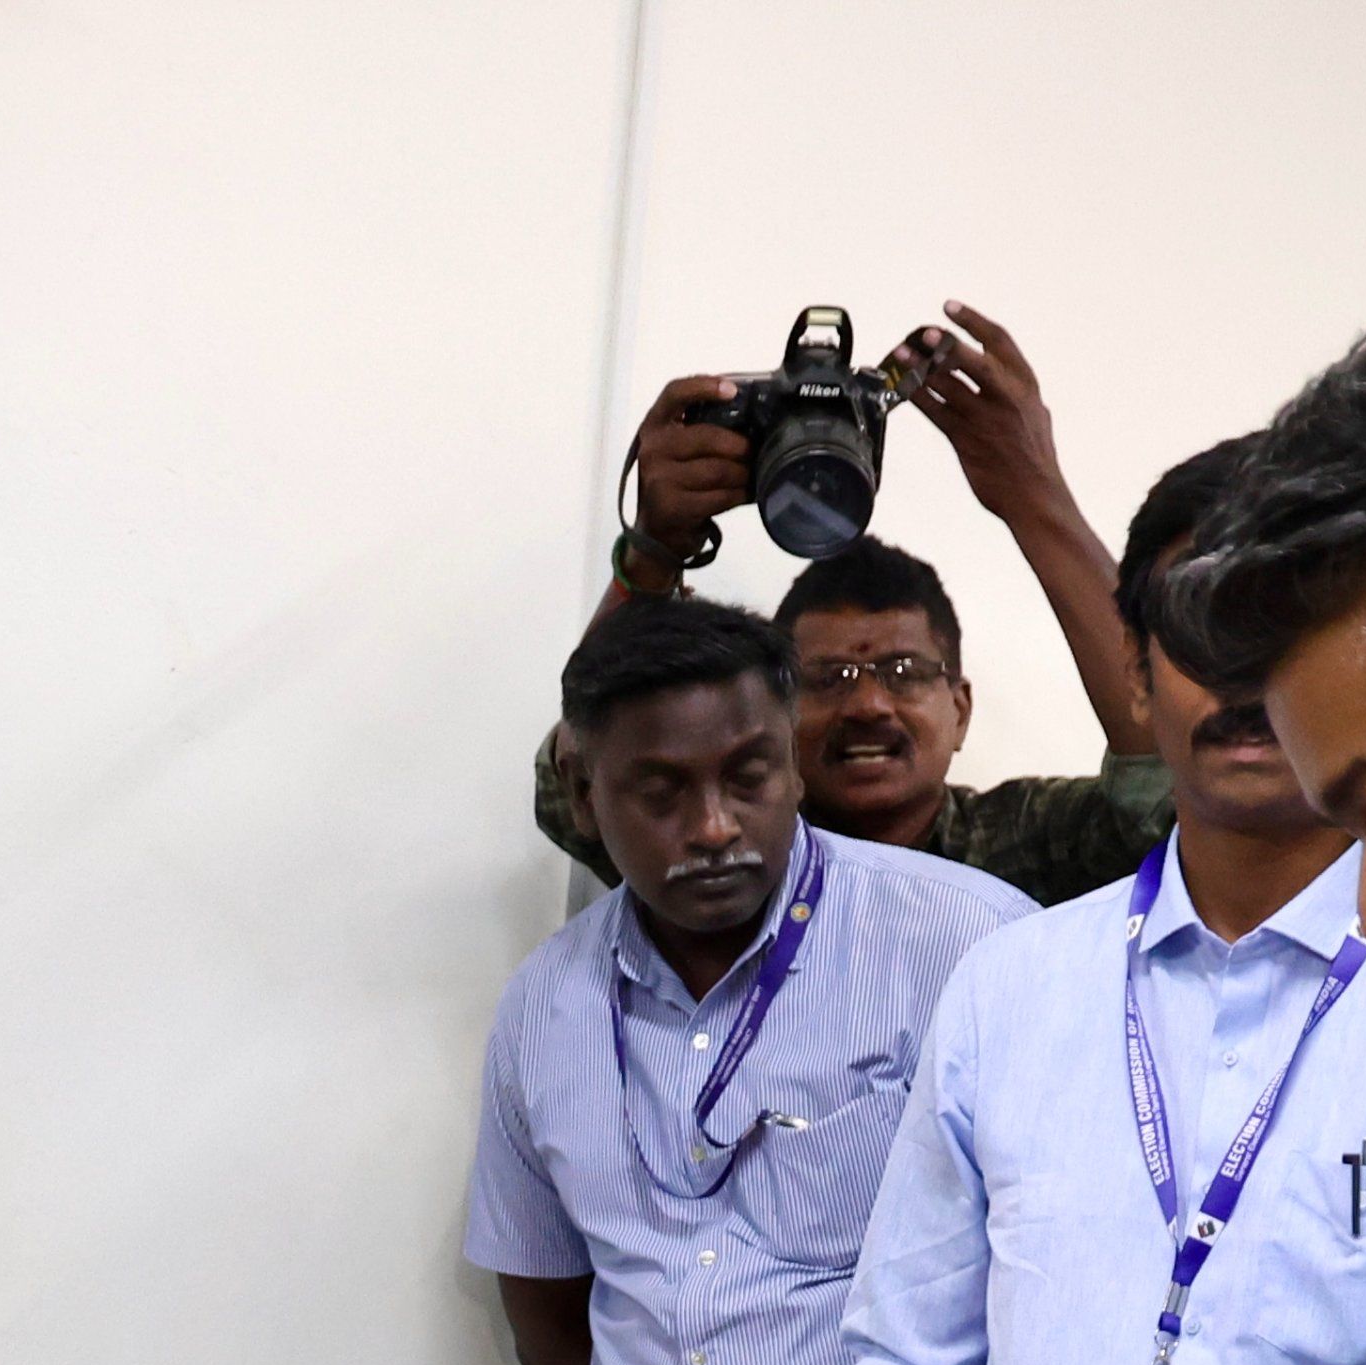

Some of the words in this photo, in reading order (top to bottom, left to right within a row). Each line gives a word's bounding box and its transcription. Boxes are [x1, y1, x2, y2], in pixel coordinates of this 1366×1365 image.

[799, 384, 840, 397] Nikon
[1128, 1036, 1154, 1122] COMMISSION
[1139, 1122, 1165, 1186] ELECTION
[1220, 1116, 1262, 1178] ELECTION
